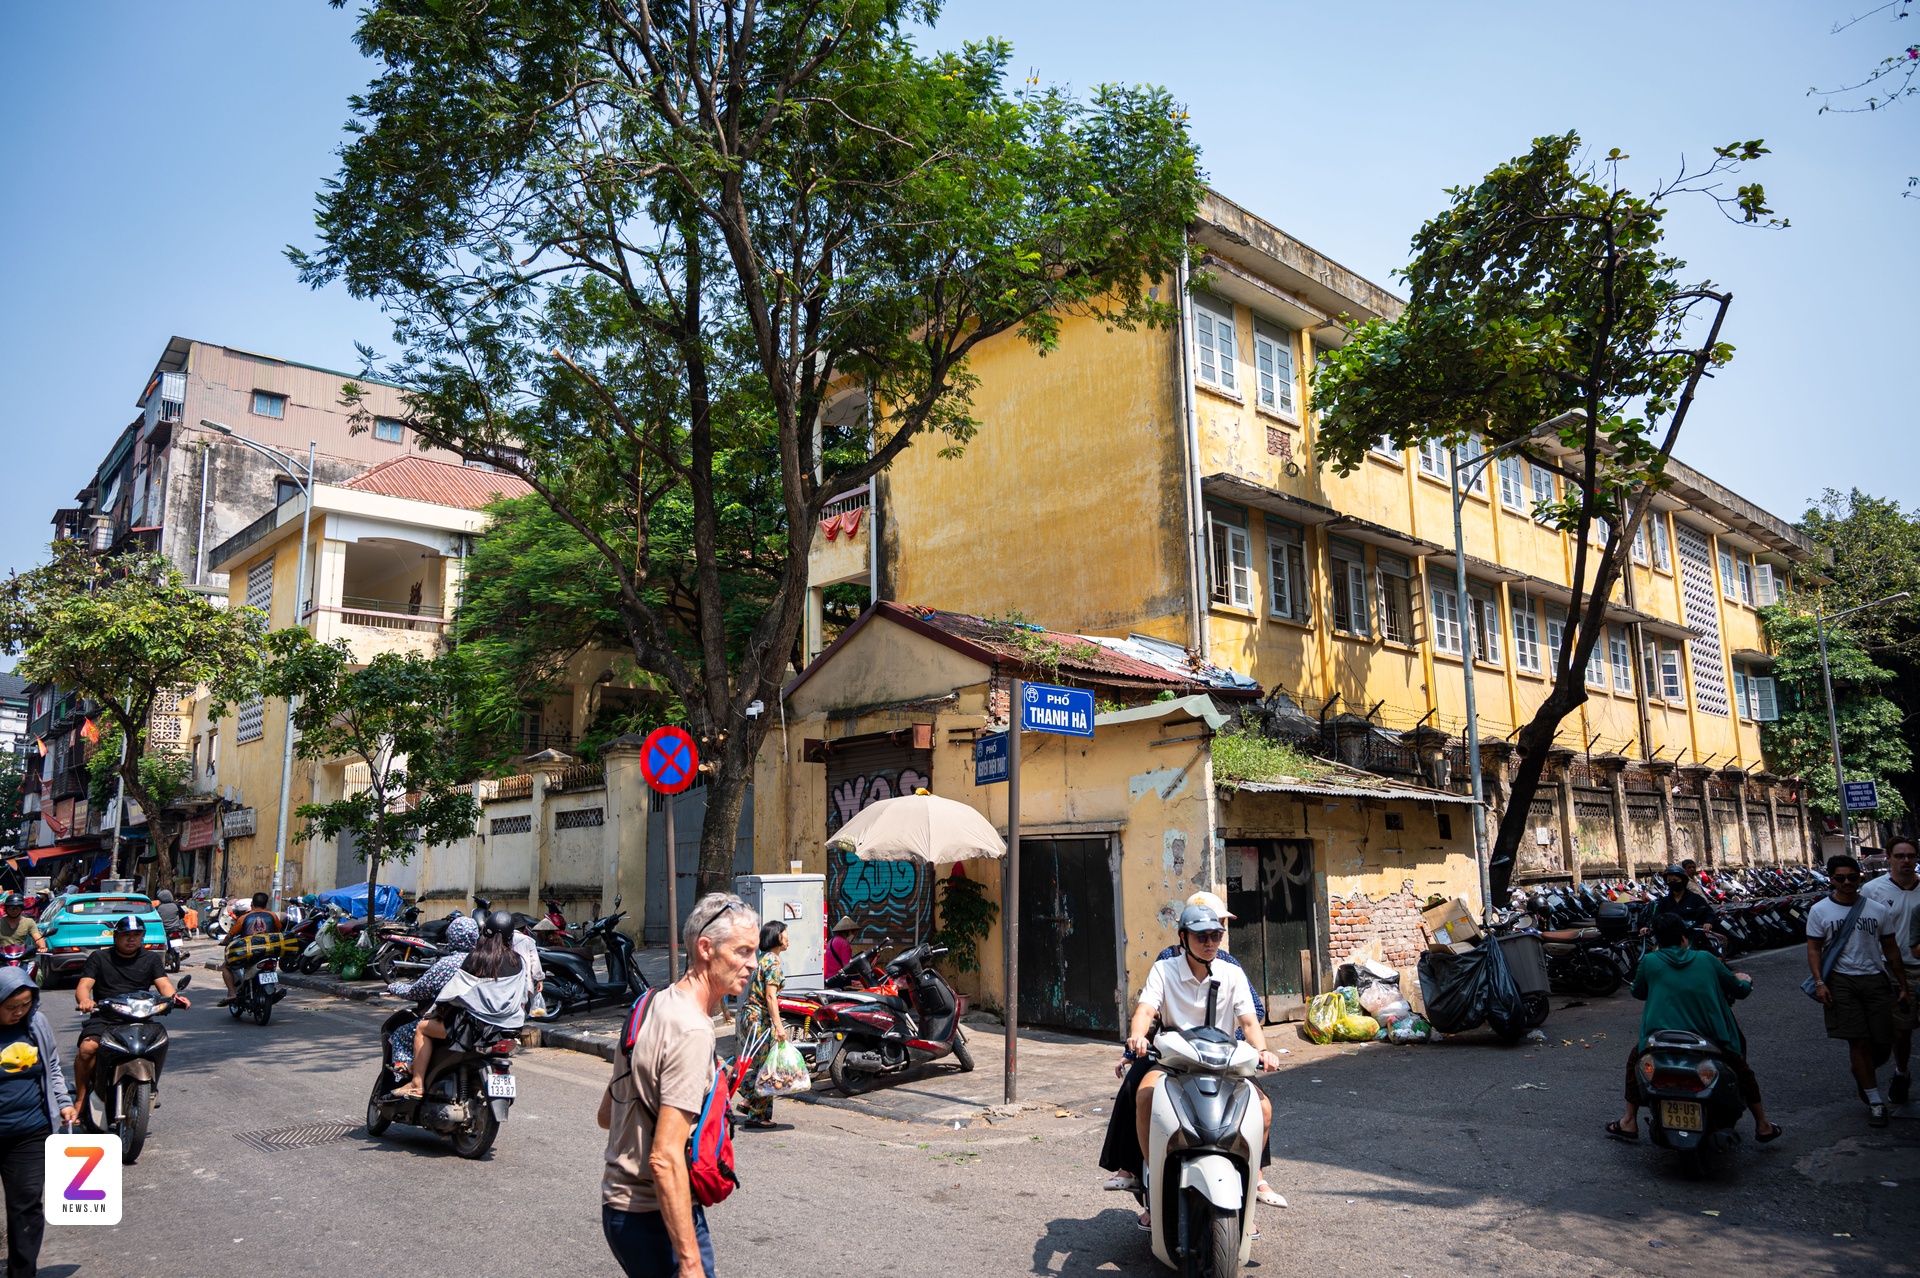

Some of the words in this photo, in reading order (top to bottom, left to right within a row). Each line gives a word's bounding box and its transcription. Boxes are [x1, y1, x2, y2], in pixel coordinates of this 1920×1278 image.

[1046, 693, 1070, 706] PHỐ
[1030, 706, 1069, 727] THANH
[1072, 709, 1088, 730] HÀ
[986, 740, 997, 755] PHỐ
[491, 1086, 514, 1095] 133.87
[1667, 1102, 1695, 1115] 29-U3
[1668, 1115, 1697, 1128] 2999
